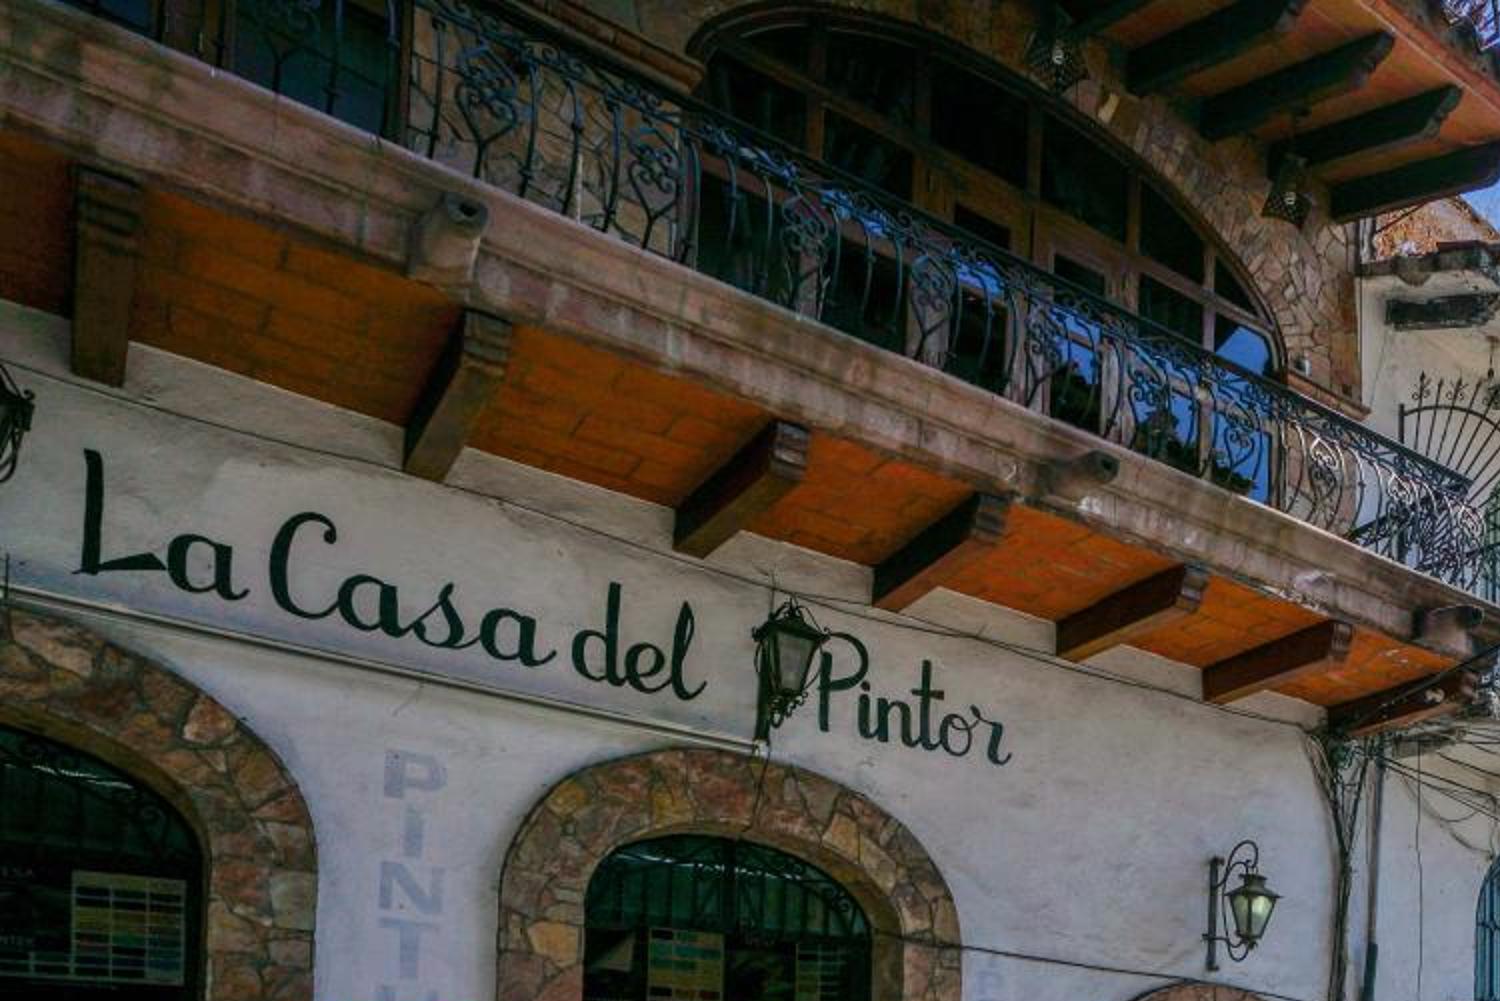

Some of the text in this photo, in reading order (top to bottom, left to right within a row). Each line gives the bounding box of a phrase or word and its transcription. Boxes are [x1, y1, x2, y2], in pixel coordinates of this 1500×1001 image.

[71, 447, 1012, 766] La Casa del Pintor
